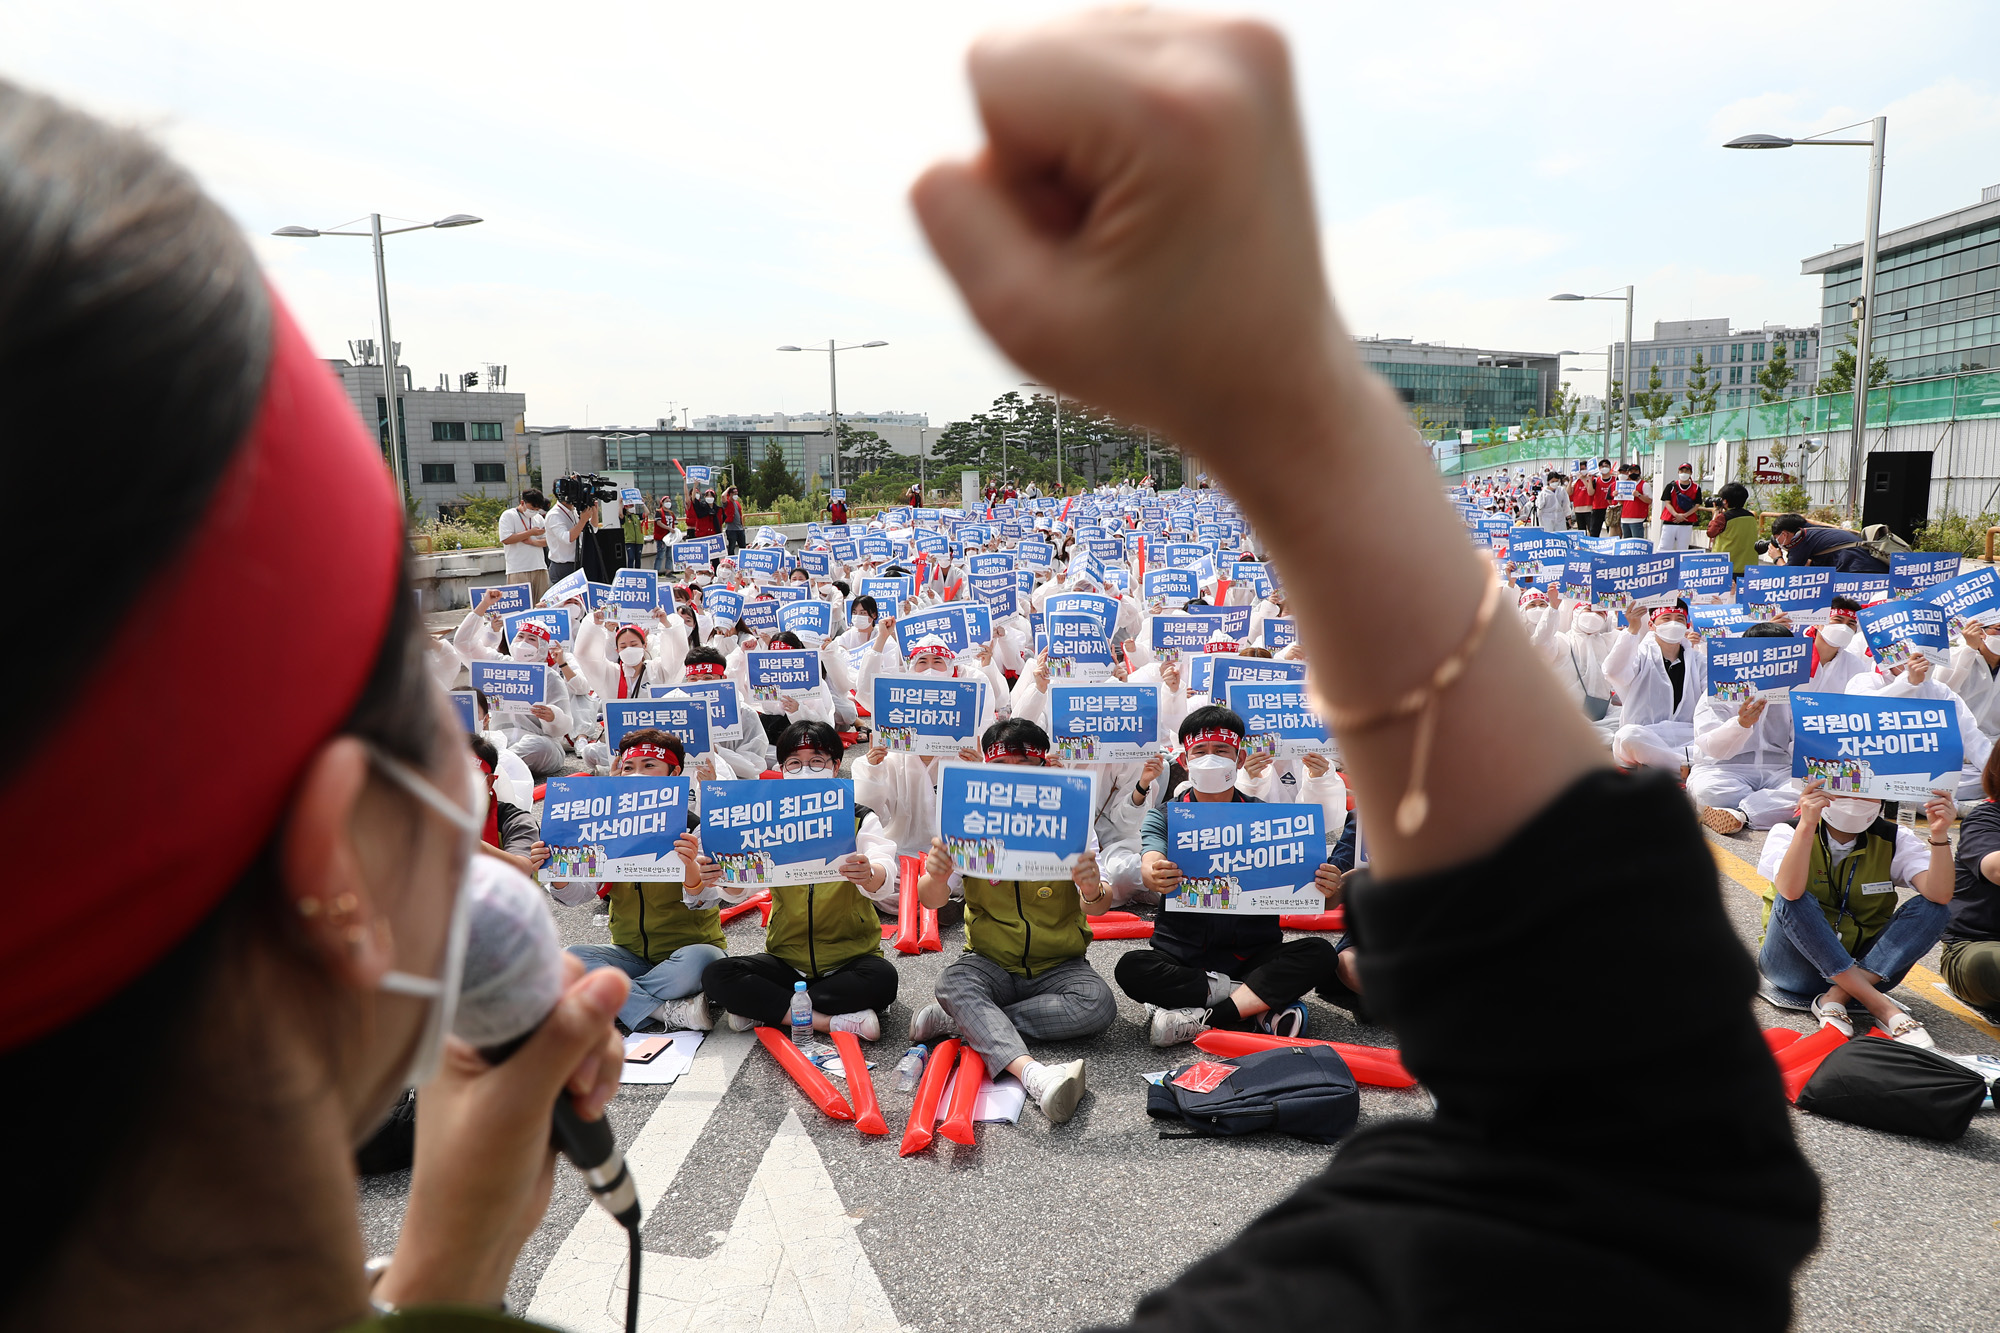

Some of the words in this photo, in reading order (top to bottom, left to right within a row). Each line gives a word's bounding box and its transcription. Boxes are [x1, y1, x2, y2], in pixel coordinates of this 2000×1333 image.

[1513, 540, 1543, 552] 직원이
[1545, 539, 1568, 550] 최고의
[977, 558, 1006, 566] 파업투쟁
[1528, 548, 1567, 560] 자산이다!
[1568, 562, 1592, 572] 직원
[1596, 564, 1634, 580] 직원이
[1637, 558, 1674, 573] 최고의
[1680, 569, 1698, 578] 원이
[1701, 566, 1729, 576] 최고의
[1894, 562, 1931, 576] 직원이
[1934, 557, 1959, 570] 최고의
[616, 576, 647, 588] 업투쟁
[868, 582, 899, 590] 파업투쟁
[1152, 574, 1188, 584] 파업투쟁
[1614, 572, 1668, 591] 자산이다!
[1684, 576, 1724, 588] 자산이다!
[1748, 576, 1785, 590] 직원이
[1788, 572, 1830, 586] 최고의
[608, 591, 650, 602] 승리하자!
[1152, 584, 1192, 593] 승리하자!
[1764, 586, 1820, 602] 자산이다!
[1930, 590, 1956, 606] 원이
[1954, 572, 1995, 596] 최고의
[992, 602, 1010, 615] 하자!
[1056, 600, 1105, 613] 파업투쟁
[1944, 587, 1995, 618] 자산이다!
[783, 605, 819, 620] 파업투쟁
[1694, 609, 1728, 618] 직원이
[784, 616, 822, 632] 승리하자!
[904, 616, 952, 638] 파업투쟁
[1163, 622, 1208, 633] 파업투쟁
[1866, 610, 1909, 635] 직원이
[1912, 609, 1944, 623] 최고의
[1889, 624, 1940, 642] 자산이다!
[1052, 640, 1108, 654] 승리하자!
[1713, 649, 1759, 666] 직원이
[1763, 644, 1807, 660] 최고의
[695, 664, 713, 673] 투쟁
[759, 658, 805, 669] 파업투쟁
[1734, 660, 1798, 680] 자산이다!
[483, 668, 530, 680] 파업투쟁
[760, 670, 809, 683] 승리하자!
[482, 682, 534, 695] 승리하자!
[890, 688, 956, 706] 파업투쟁
[1068, 696, 1138, 712] 파업투쟁
[622, 710, 688, 726] 파업투쟁
[888, 707, 960, 726] 승리하자!
[1068, 716, 1143, 732] 승리하자!
[1248, 713, 1323, 731] 승리하자!
[1802, 712, 1871, 734] 직원이
[1877, 709, 1948, 731] 최고의
[1218, 728, 1239, 746] 투쟁
[1837, 732, 1939, 756] 자산이다!
[640, 744, 666, 759] 투쟁
[988, 742, 1006, 758] 단결
[551, 796, 612, 821] 직원이
[618, 786, 679, 814] 최고의
[965, 781, 1062, 810] 파업투쟁
[709, 800, 772, 828] 직원이
[779, 789, 844, 819] 최고의
[578, 812, 667, 842] 자산이다!
[740, 816, 833, 850] 자산이다!
[963, 810, 1068, 840] 승리하자!
[1177, 823, 1243, 851] 직원이
[1250, 814, 1315, 843] 최고의
[1208, 842, 1304, 874] 자산이다!
